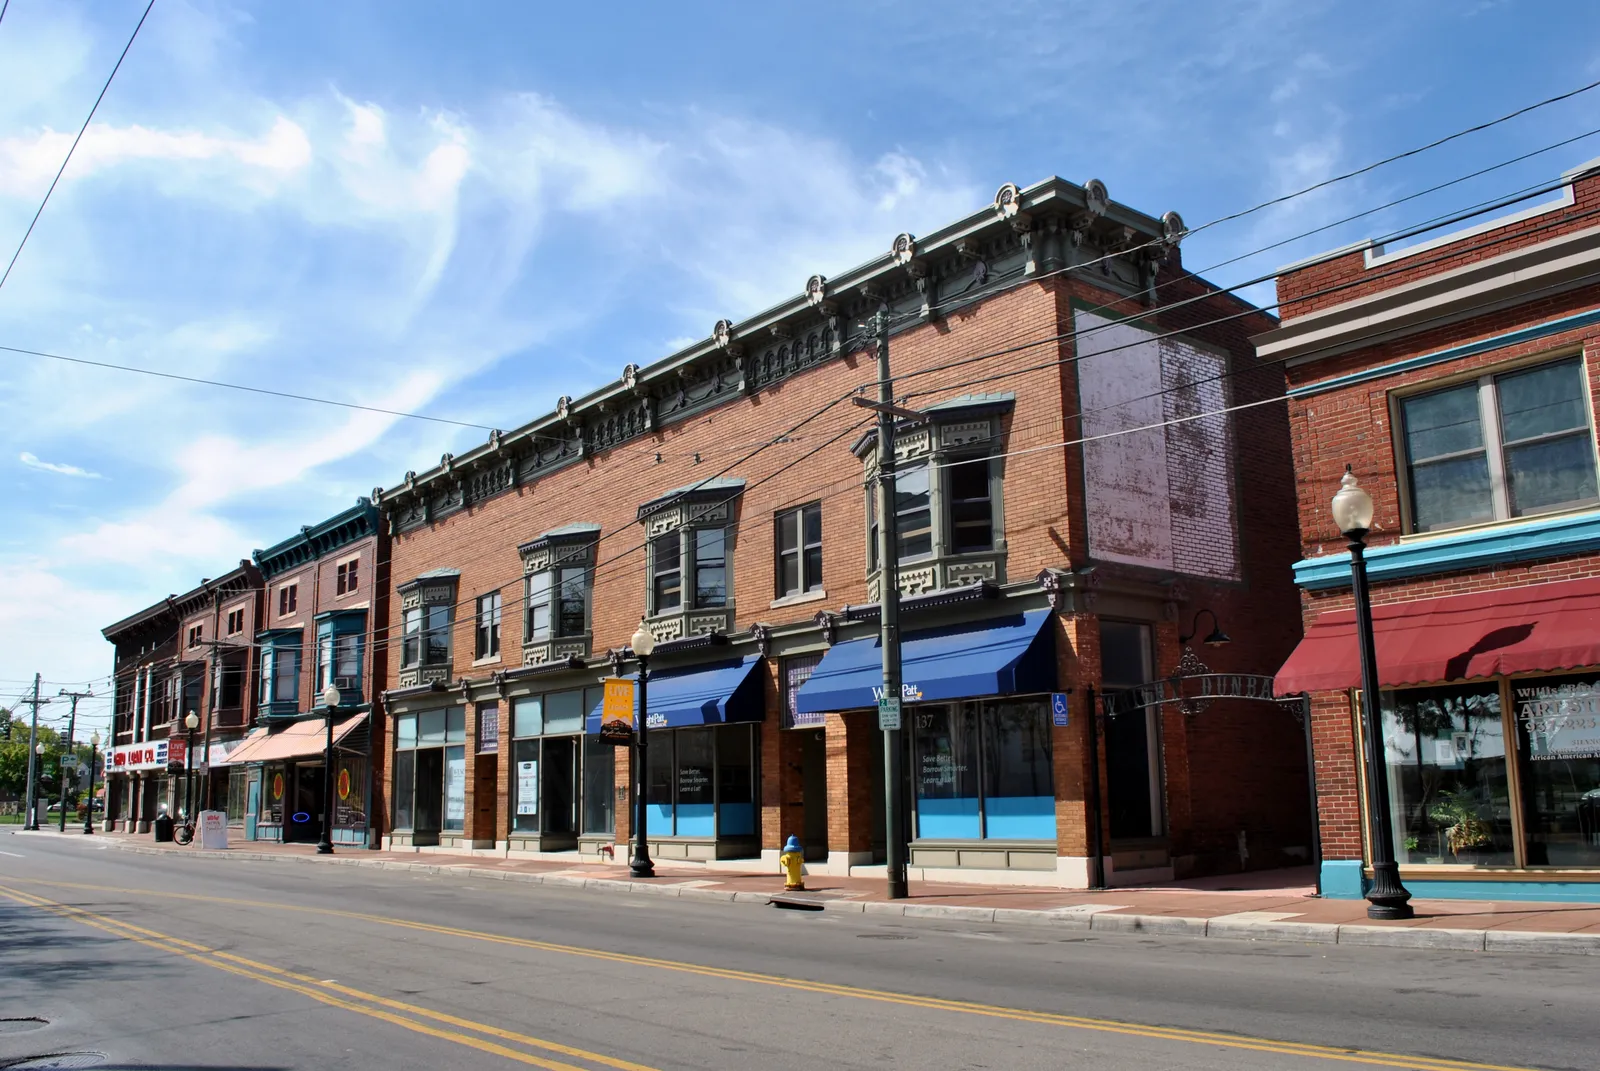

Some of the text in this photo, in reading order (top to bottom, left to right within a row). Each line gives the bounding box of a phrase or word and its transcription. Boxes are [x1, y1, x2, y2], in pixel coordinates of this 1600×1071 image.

[609, 685, 630, 697] LIVE
[1201, 676, 1274, 701] DUNBA
[1517, 687, 1558, 698] Willis
[1520, 698, 1600, 717] ART ST
[916, 714, 934, 729] 137
[923, 766, 942, 774] Borrow
